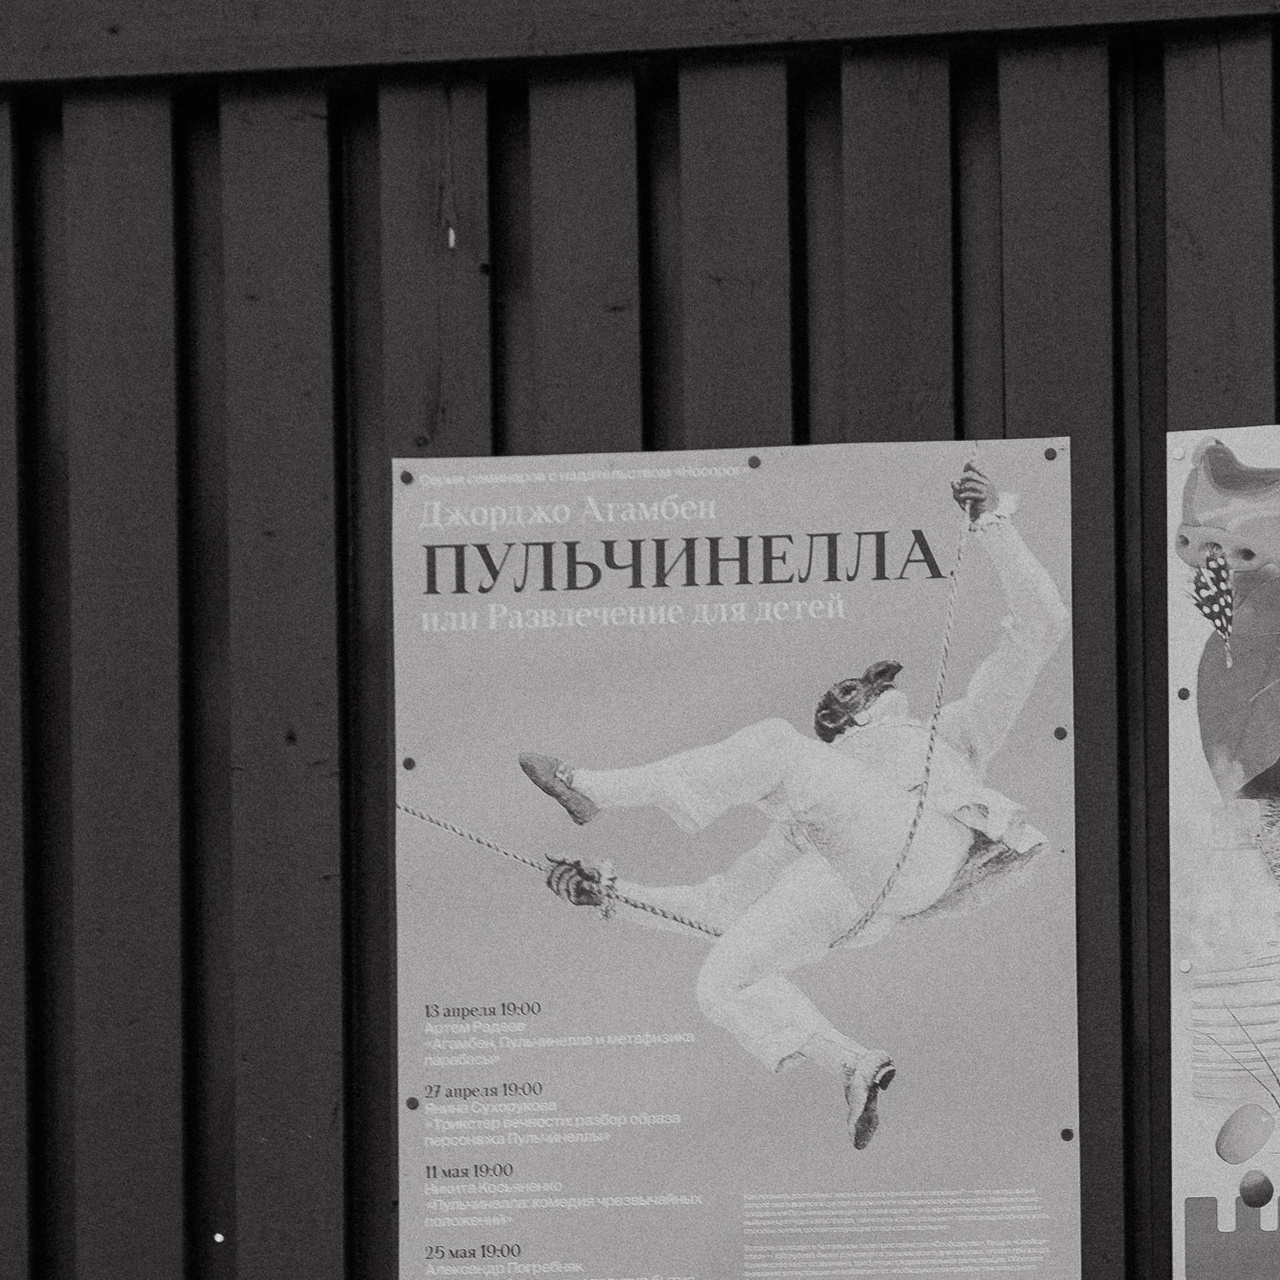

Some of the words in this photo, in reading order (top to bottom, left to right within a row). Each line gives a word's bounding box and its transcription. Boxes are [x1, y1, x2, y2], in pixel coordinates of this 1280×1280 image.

[418, 497, 570, 532] Джорджо
[582, 494, 715, 526] Агамбен
[423, 529, 946, 595] ПУЛЬЧИНЕЛЛА
[422, 612, 478, 631] или
[488, 605, 683, 630] Развлечение
[693, 603, 746, 625] для
[755, 593, 845, 623] детей
[425, 1004, 440, 1017] 13
[443, 1007, 496, 1020] апреля
[501, 1002, 542, 1016] 19:00
[425, 1085, 440, 1098] 27
[446, 1087, 497, 1100] апреля
[502, 1082, 542, 1096] 19:00
[426, 1166, 437, 1178] 11
[442, 1168, 469, 1178] мая
[474, 1164, 513, 1177] 19:00
[425, 1246, 445, 1259] 25
[449, 1249, 476, 1258] мая
[481, 1244, 521, 1258] 19:00
